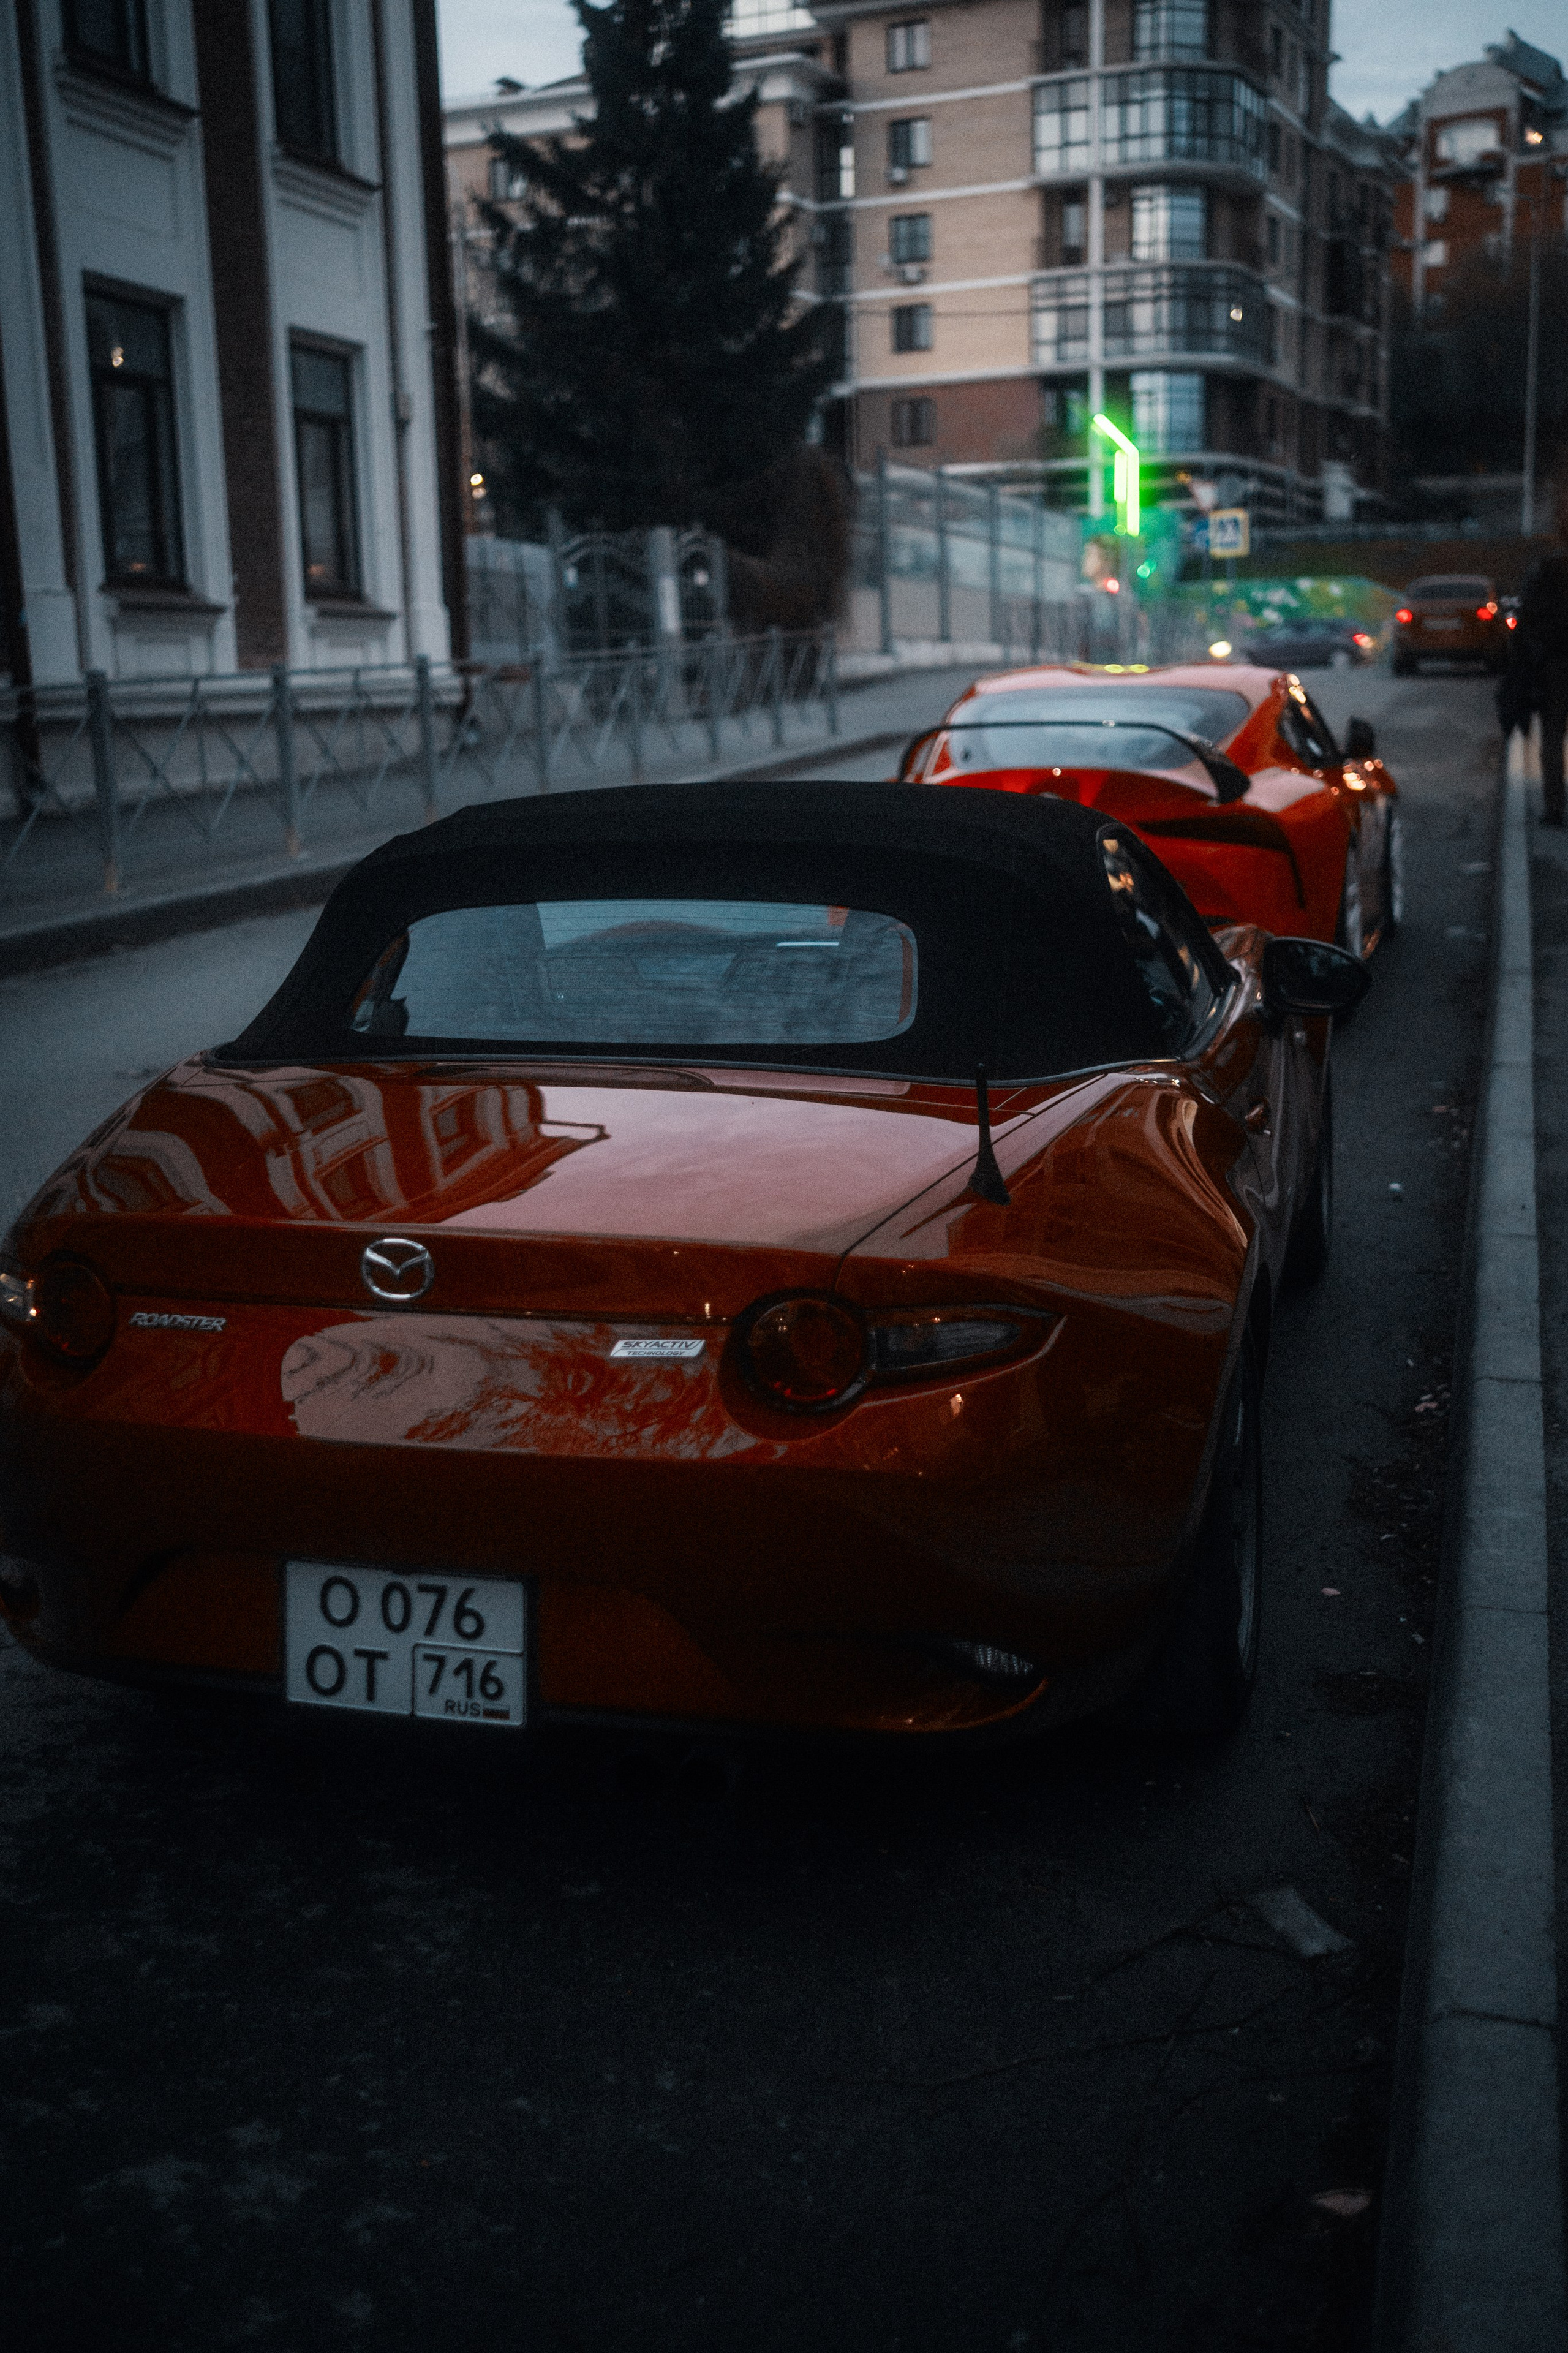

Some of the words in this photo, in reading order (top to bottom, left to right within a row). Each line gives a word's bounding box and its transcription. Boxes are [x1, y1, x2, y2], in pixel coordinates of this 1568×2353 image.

[129, 1312, 226, 1331] ROADSTER
[382, 1581, 485, 1640] 076
[306, 1644, 388, 1702] OT
[423, 1653, 504, 1701] 716
[445, 1699, 481, 1717] RUS
